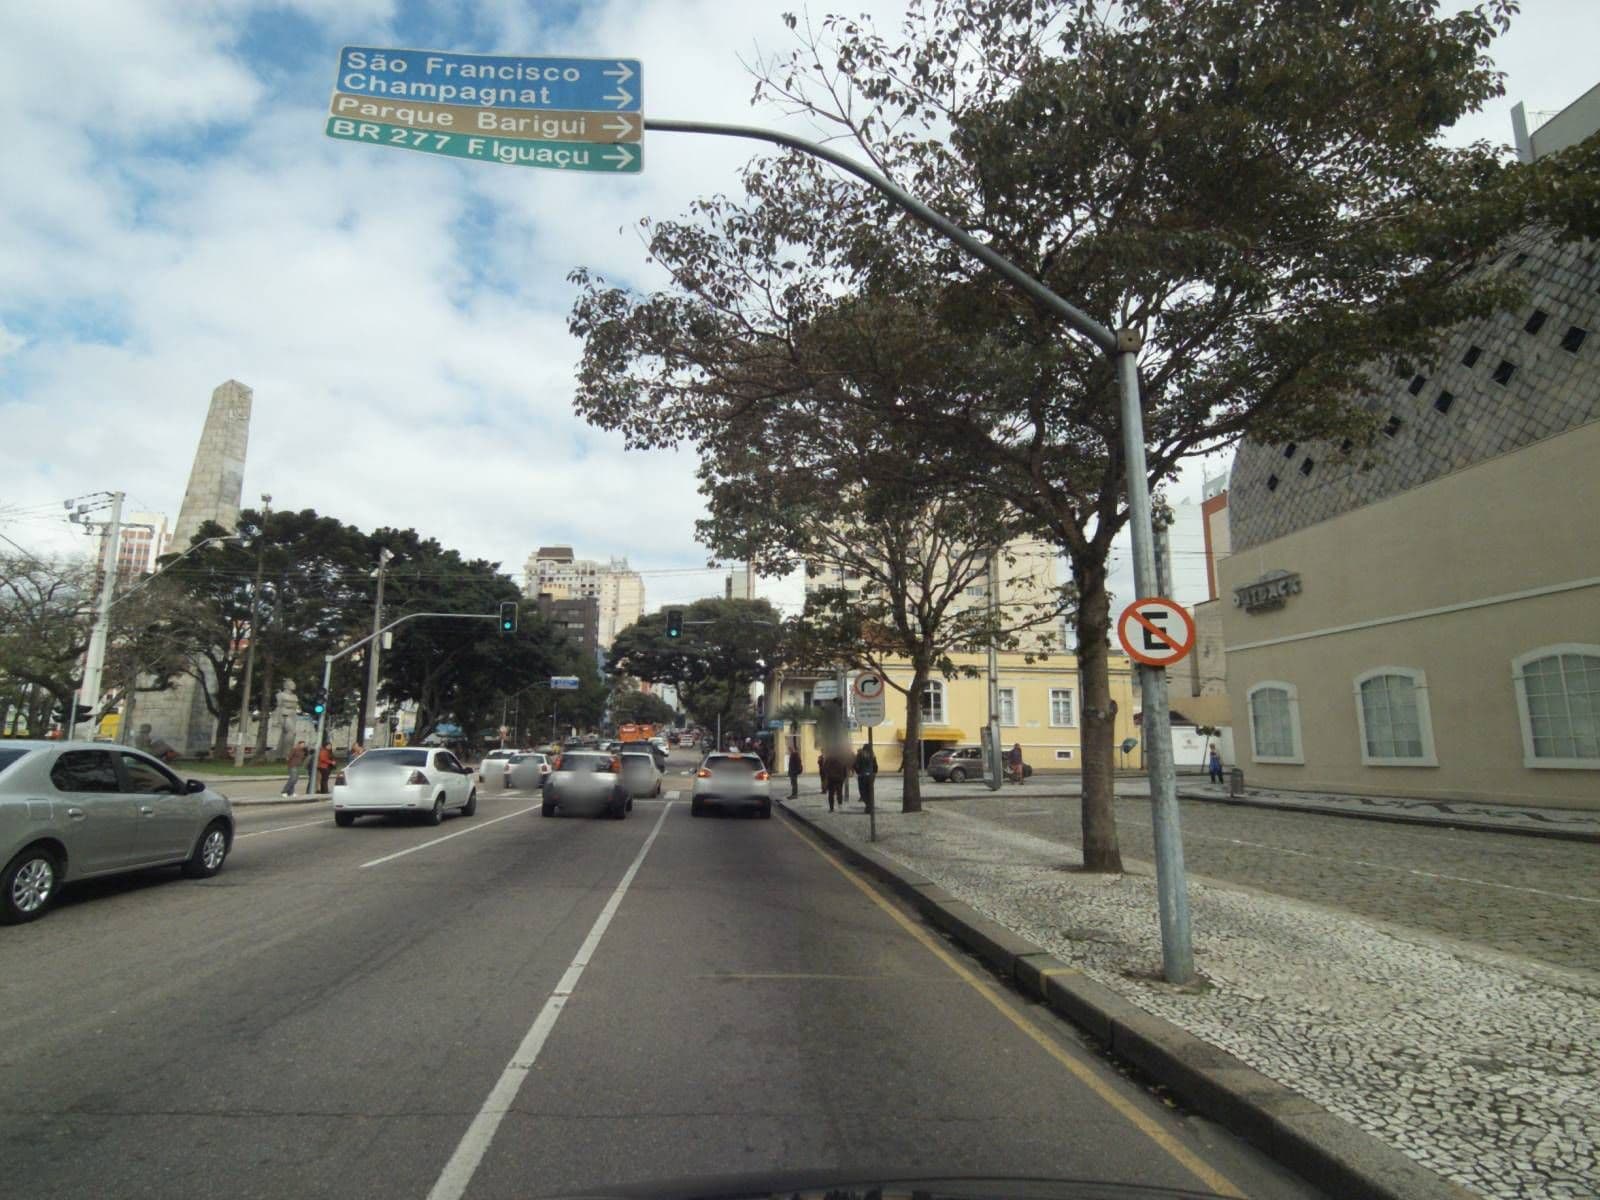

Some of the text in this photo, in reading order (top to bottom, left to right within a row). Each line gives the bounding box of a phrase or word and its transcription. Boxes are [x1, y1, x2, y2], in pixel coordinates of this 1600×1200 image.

[347, 52, 580, 82] São Francisco
[344, 73, 552, 106] Champagnat
[338, 97, 586, 138] Parque Barigui
[333, 120, 380, 140] BR
[389, 128, 451, 151] 277
[492, 140, 589, 168] Iguaçu
[1141, 611, 1172, 650] E
